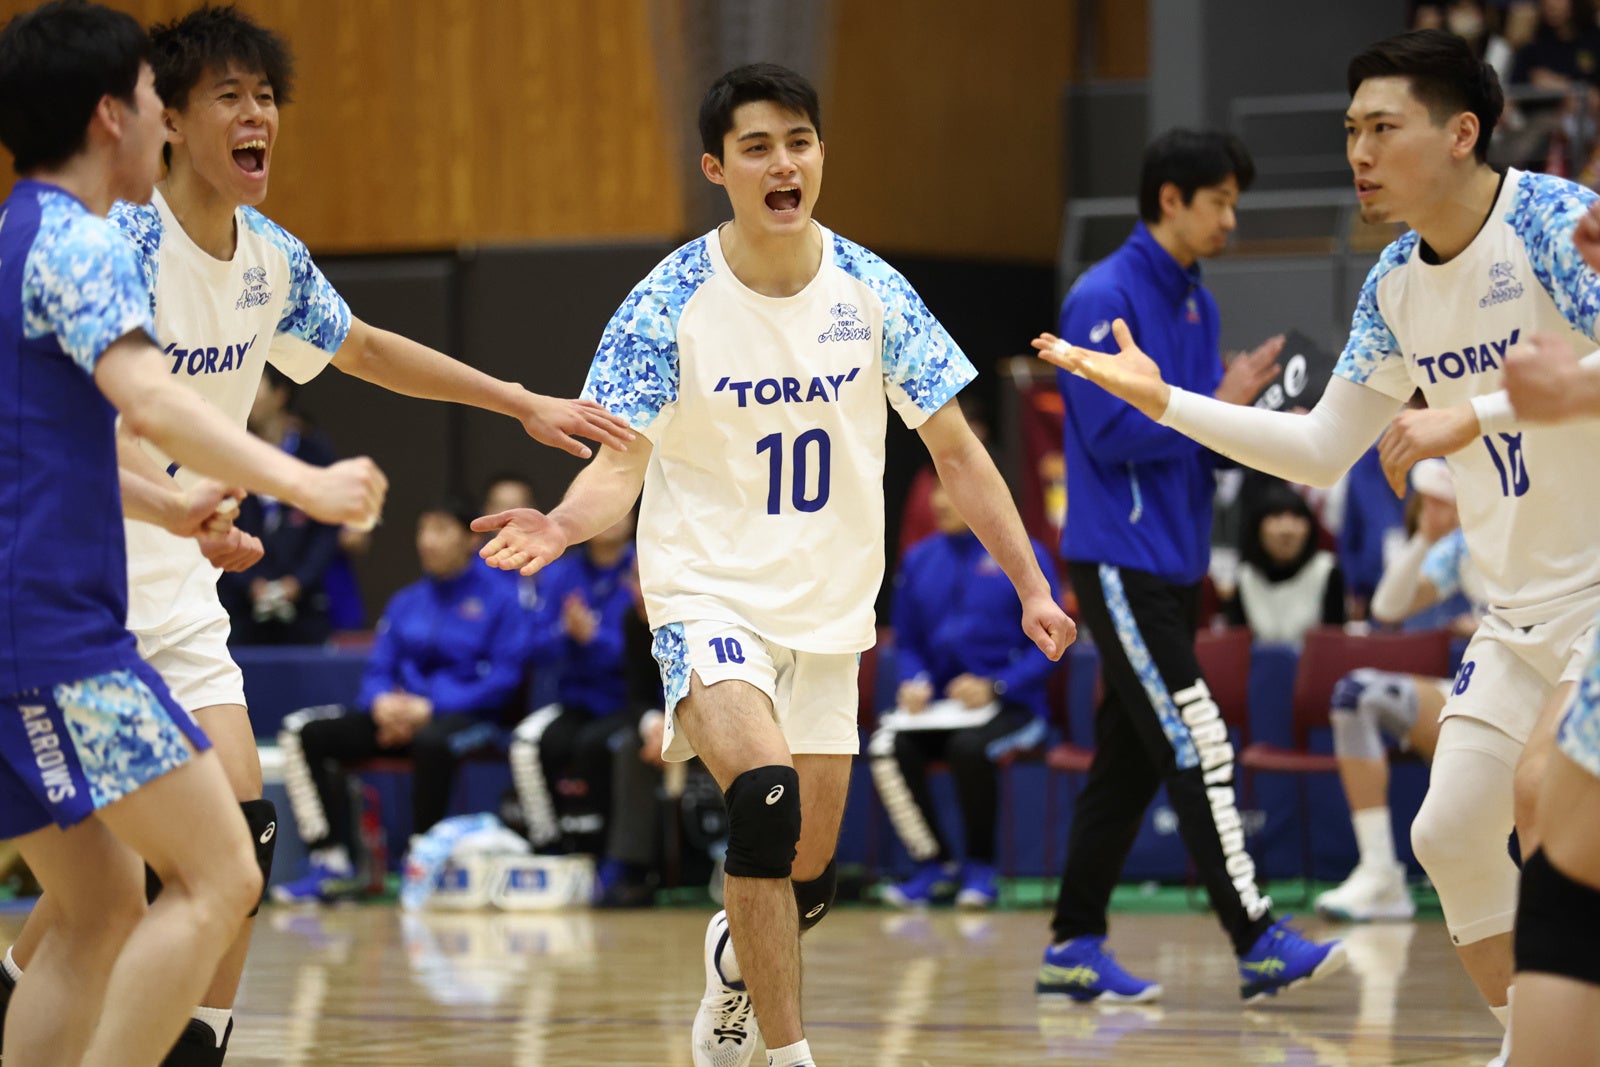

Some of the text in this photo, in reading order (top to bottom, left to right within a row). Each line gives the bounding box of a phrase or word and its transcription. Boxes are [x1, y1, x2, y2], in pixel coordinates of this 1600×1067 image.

[756, 428, 831, 515] 10
[708, 637, 746, 664] 10
[18, 704, 76, 803] ARROWS
